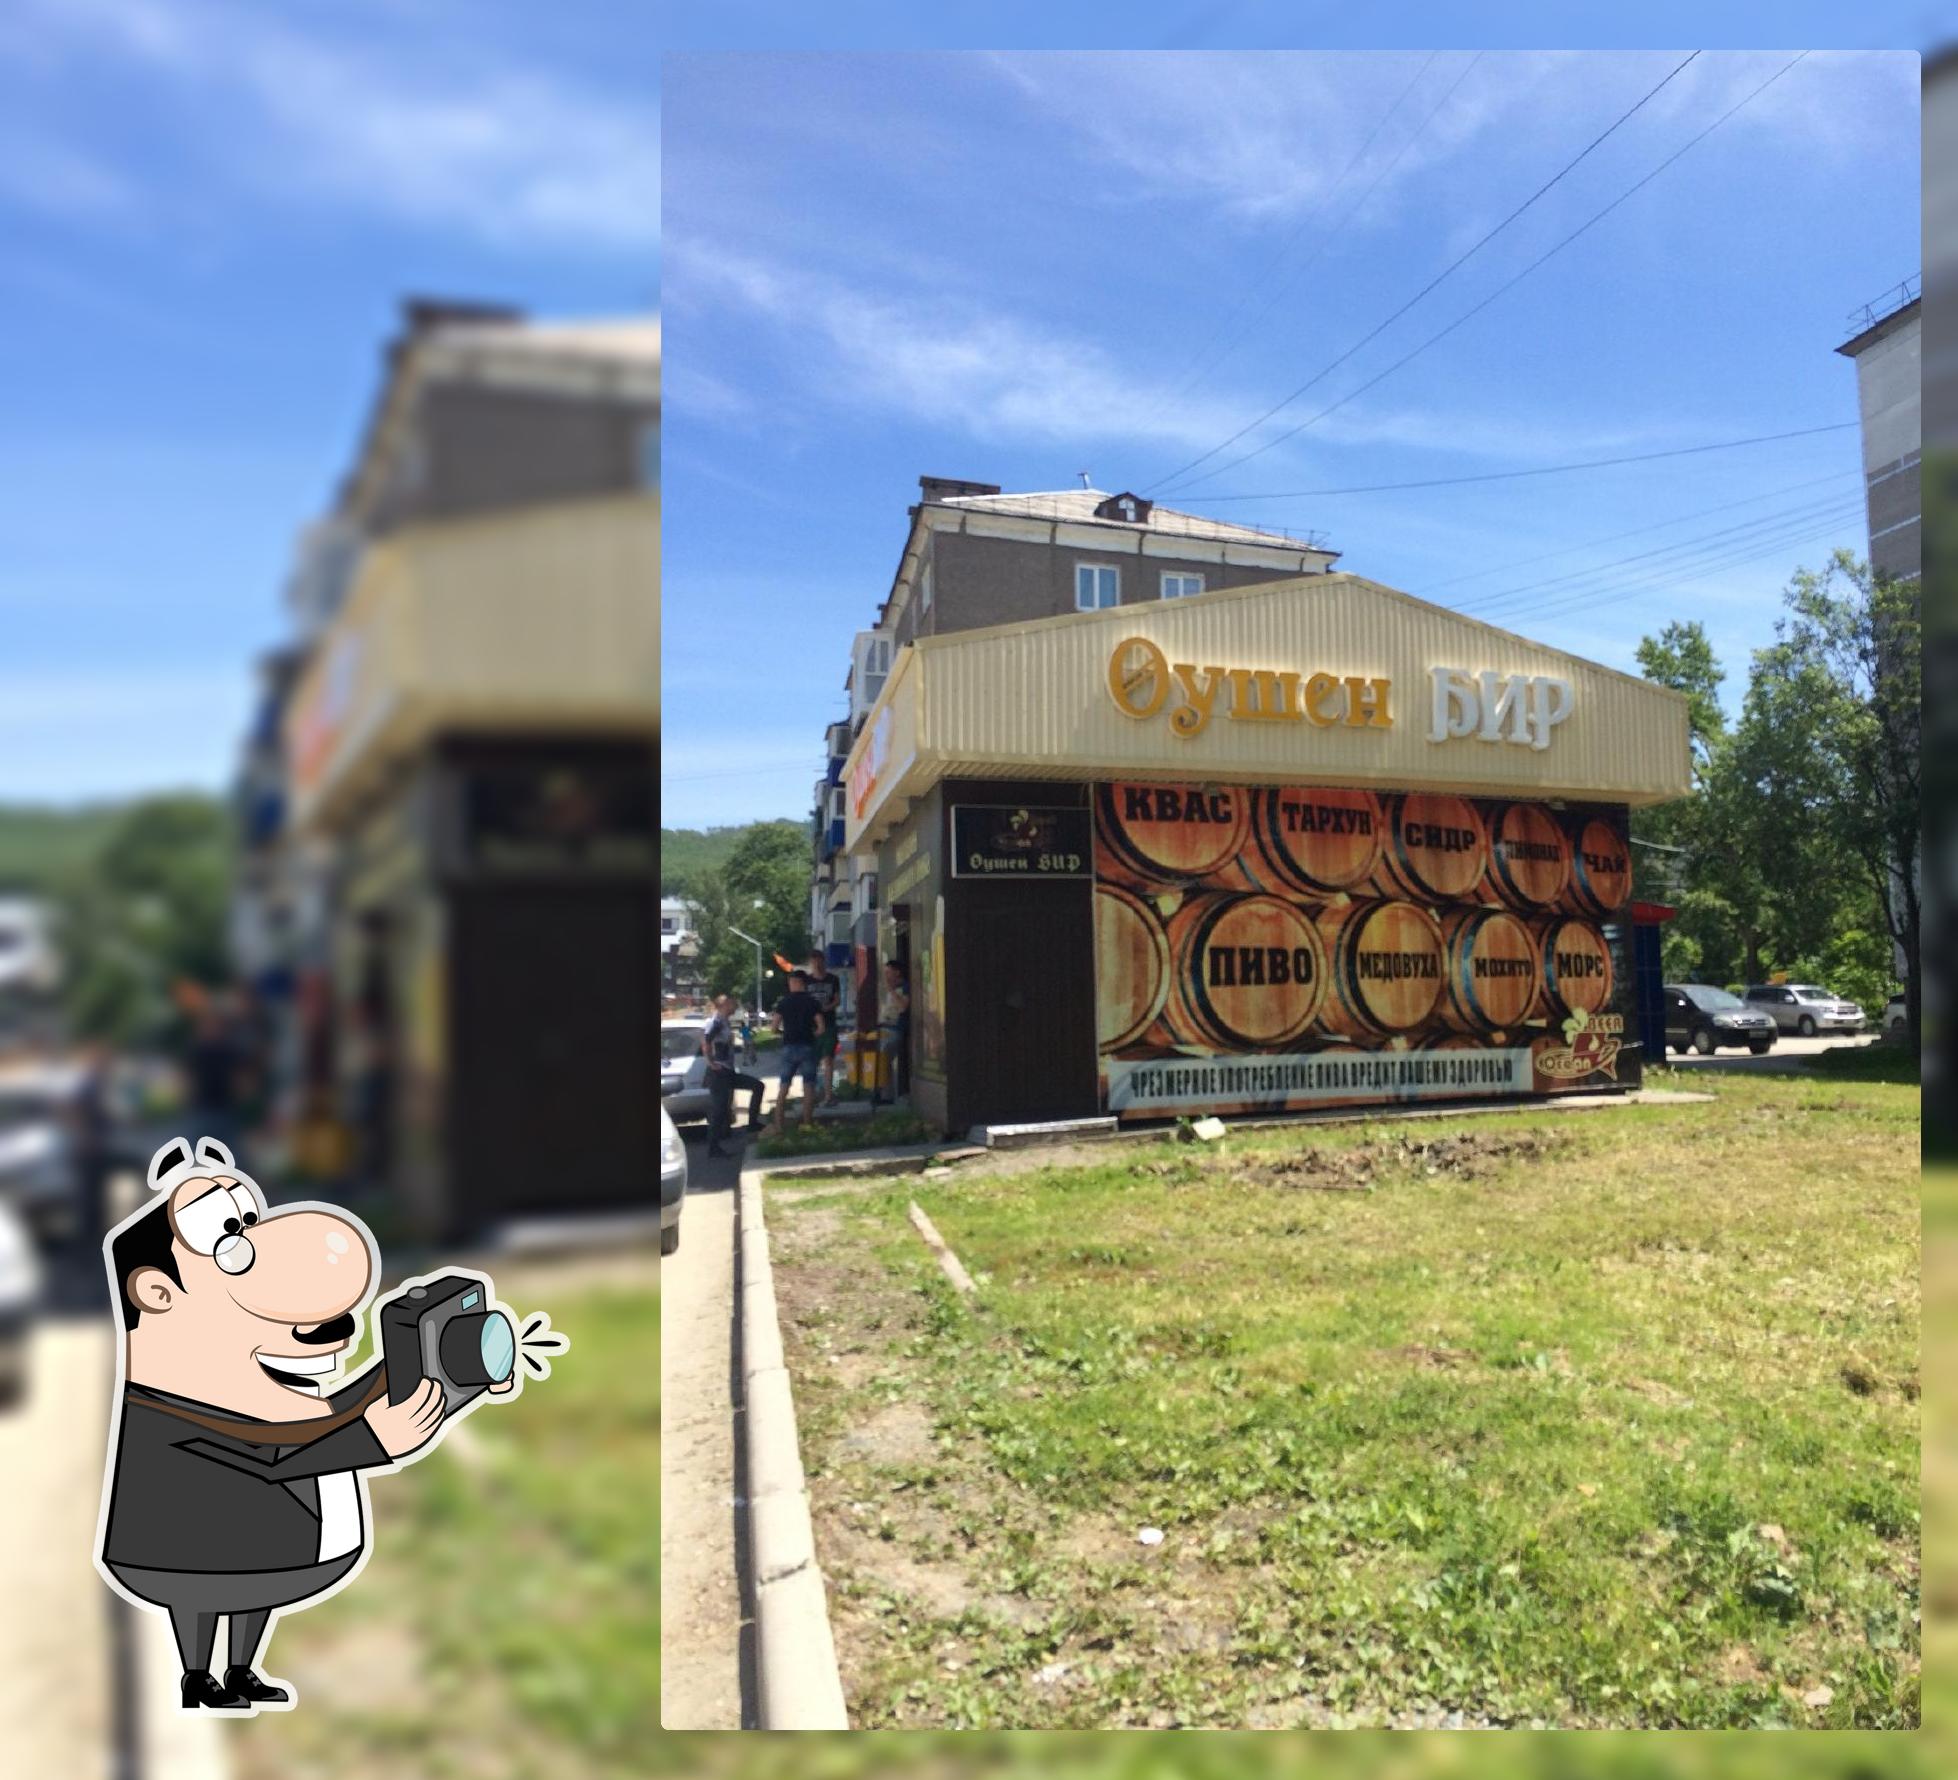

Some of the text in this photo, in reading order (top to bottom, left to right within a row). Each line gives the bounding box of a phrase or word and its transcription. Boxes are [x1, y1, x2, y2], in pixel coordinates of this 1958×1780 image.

[1109, 636, 1574, 751] Оушен БИР
[1124, 786, 1232, 824] КВАС
[1282, 801, 1371, 835] ТАРХУН
[1404, 822, 1476, 852] СИДР
[1209, 947, 1313, 987] ПИВО
[1359, 952, 1438, 983] МЕДОВУХА
[1475, 957, 1532, 978] МОХИТО
[1556, 952, 1603, 978] МОРС
[1131, 1068, 1216, 1098] ЧРЕЗМЕРНОЕ
[1316, 1063, 1348, 1089] ПИВА
[1351, 1061, 1396, 1090] ВРЕДИТ
[1400, 1060, 1447, 1085] ВАШЕМУ
[1450, 1058, 1513, 1087] ЗДОРОВЬЮ
